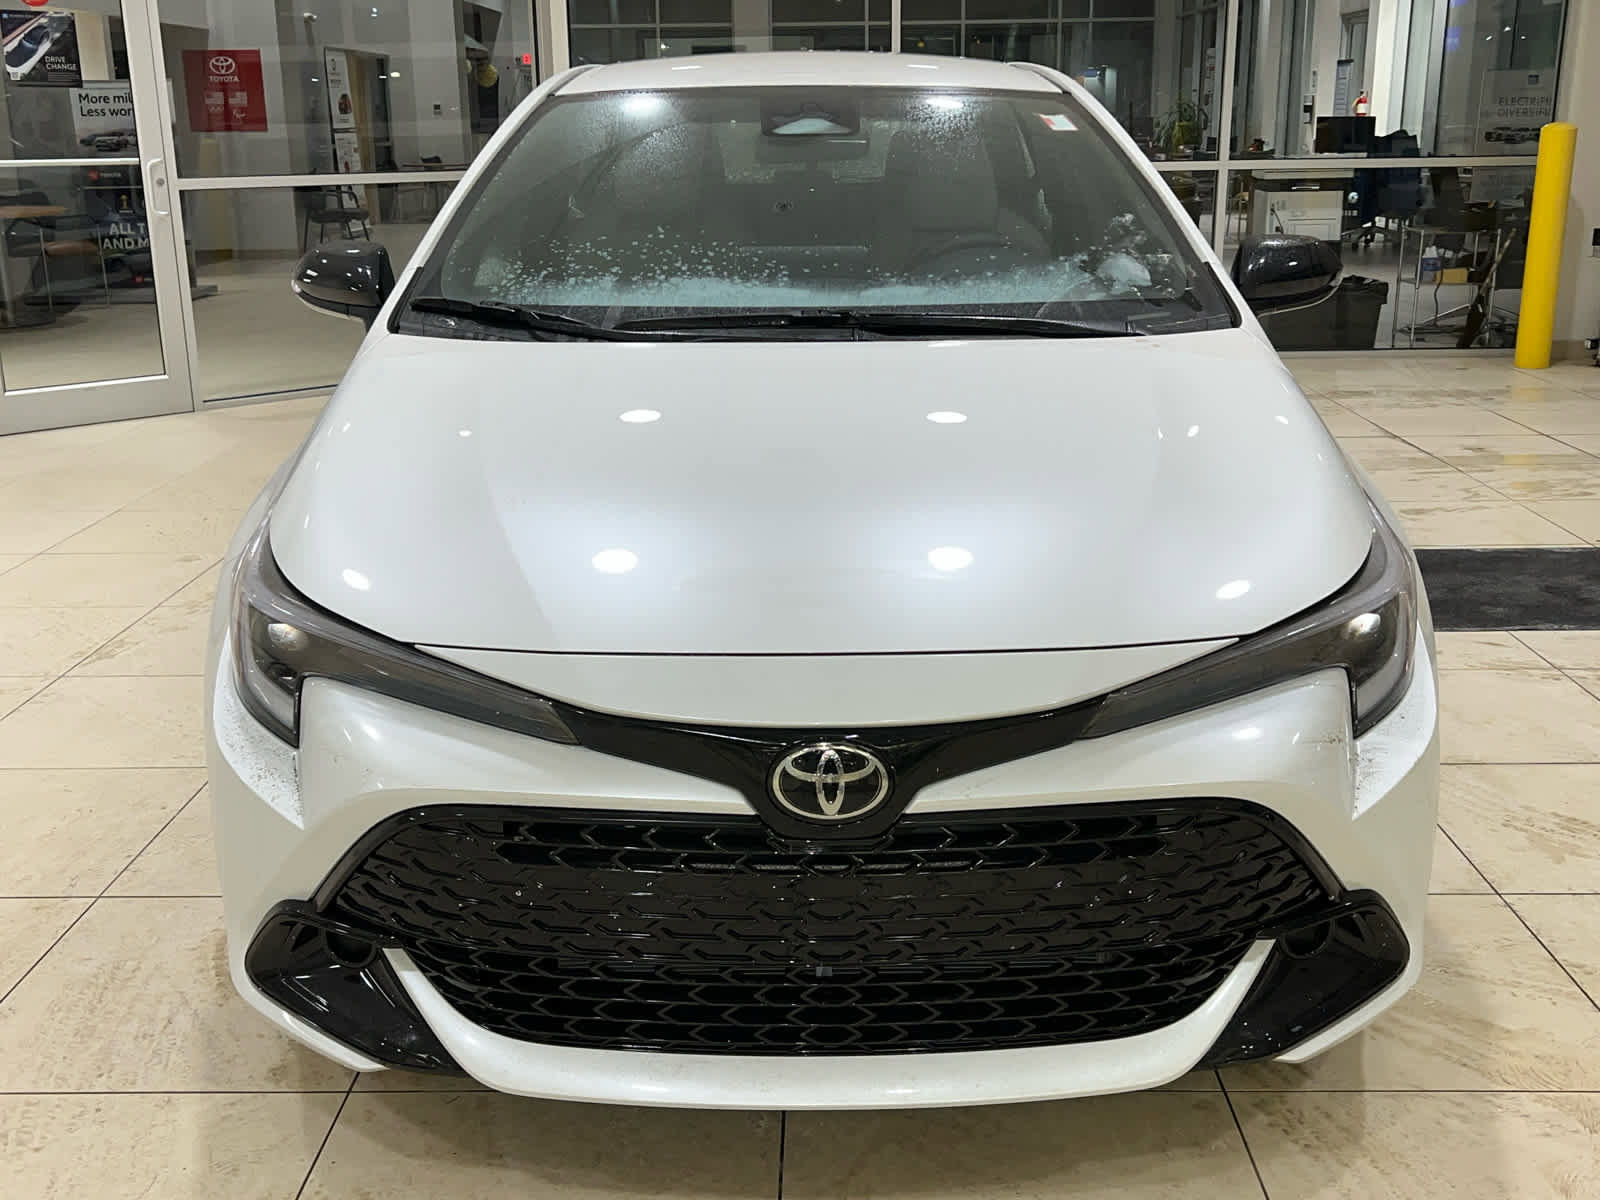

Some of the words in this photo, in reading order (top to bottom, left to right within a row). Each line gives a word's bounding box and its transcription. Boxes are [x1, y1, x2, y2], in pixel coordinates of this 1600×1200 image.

[46, 63, 77, 71] CHANGE
[78, 93, 110, 104] More
[1498, 96, 1553, 106] ELECTRIFI
[80, 106, 106, 117] Less
[110, 223, 136, 235] ALL
[103, 238, 135, 249] AND
